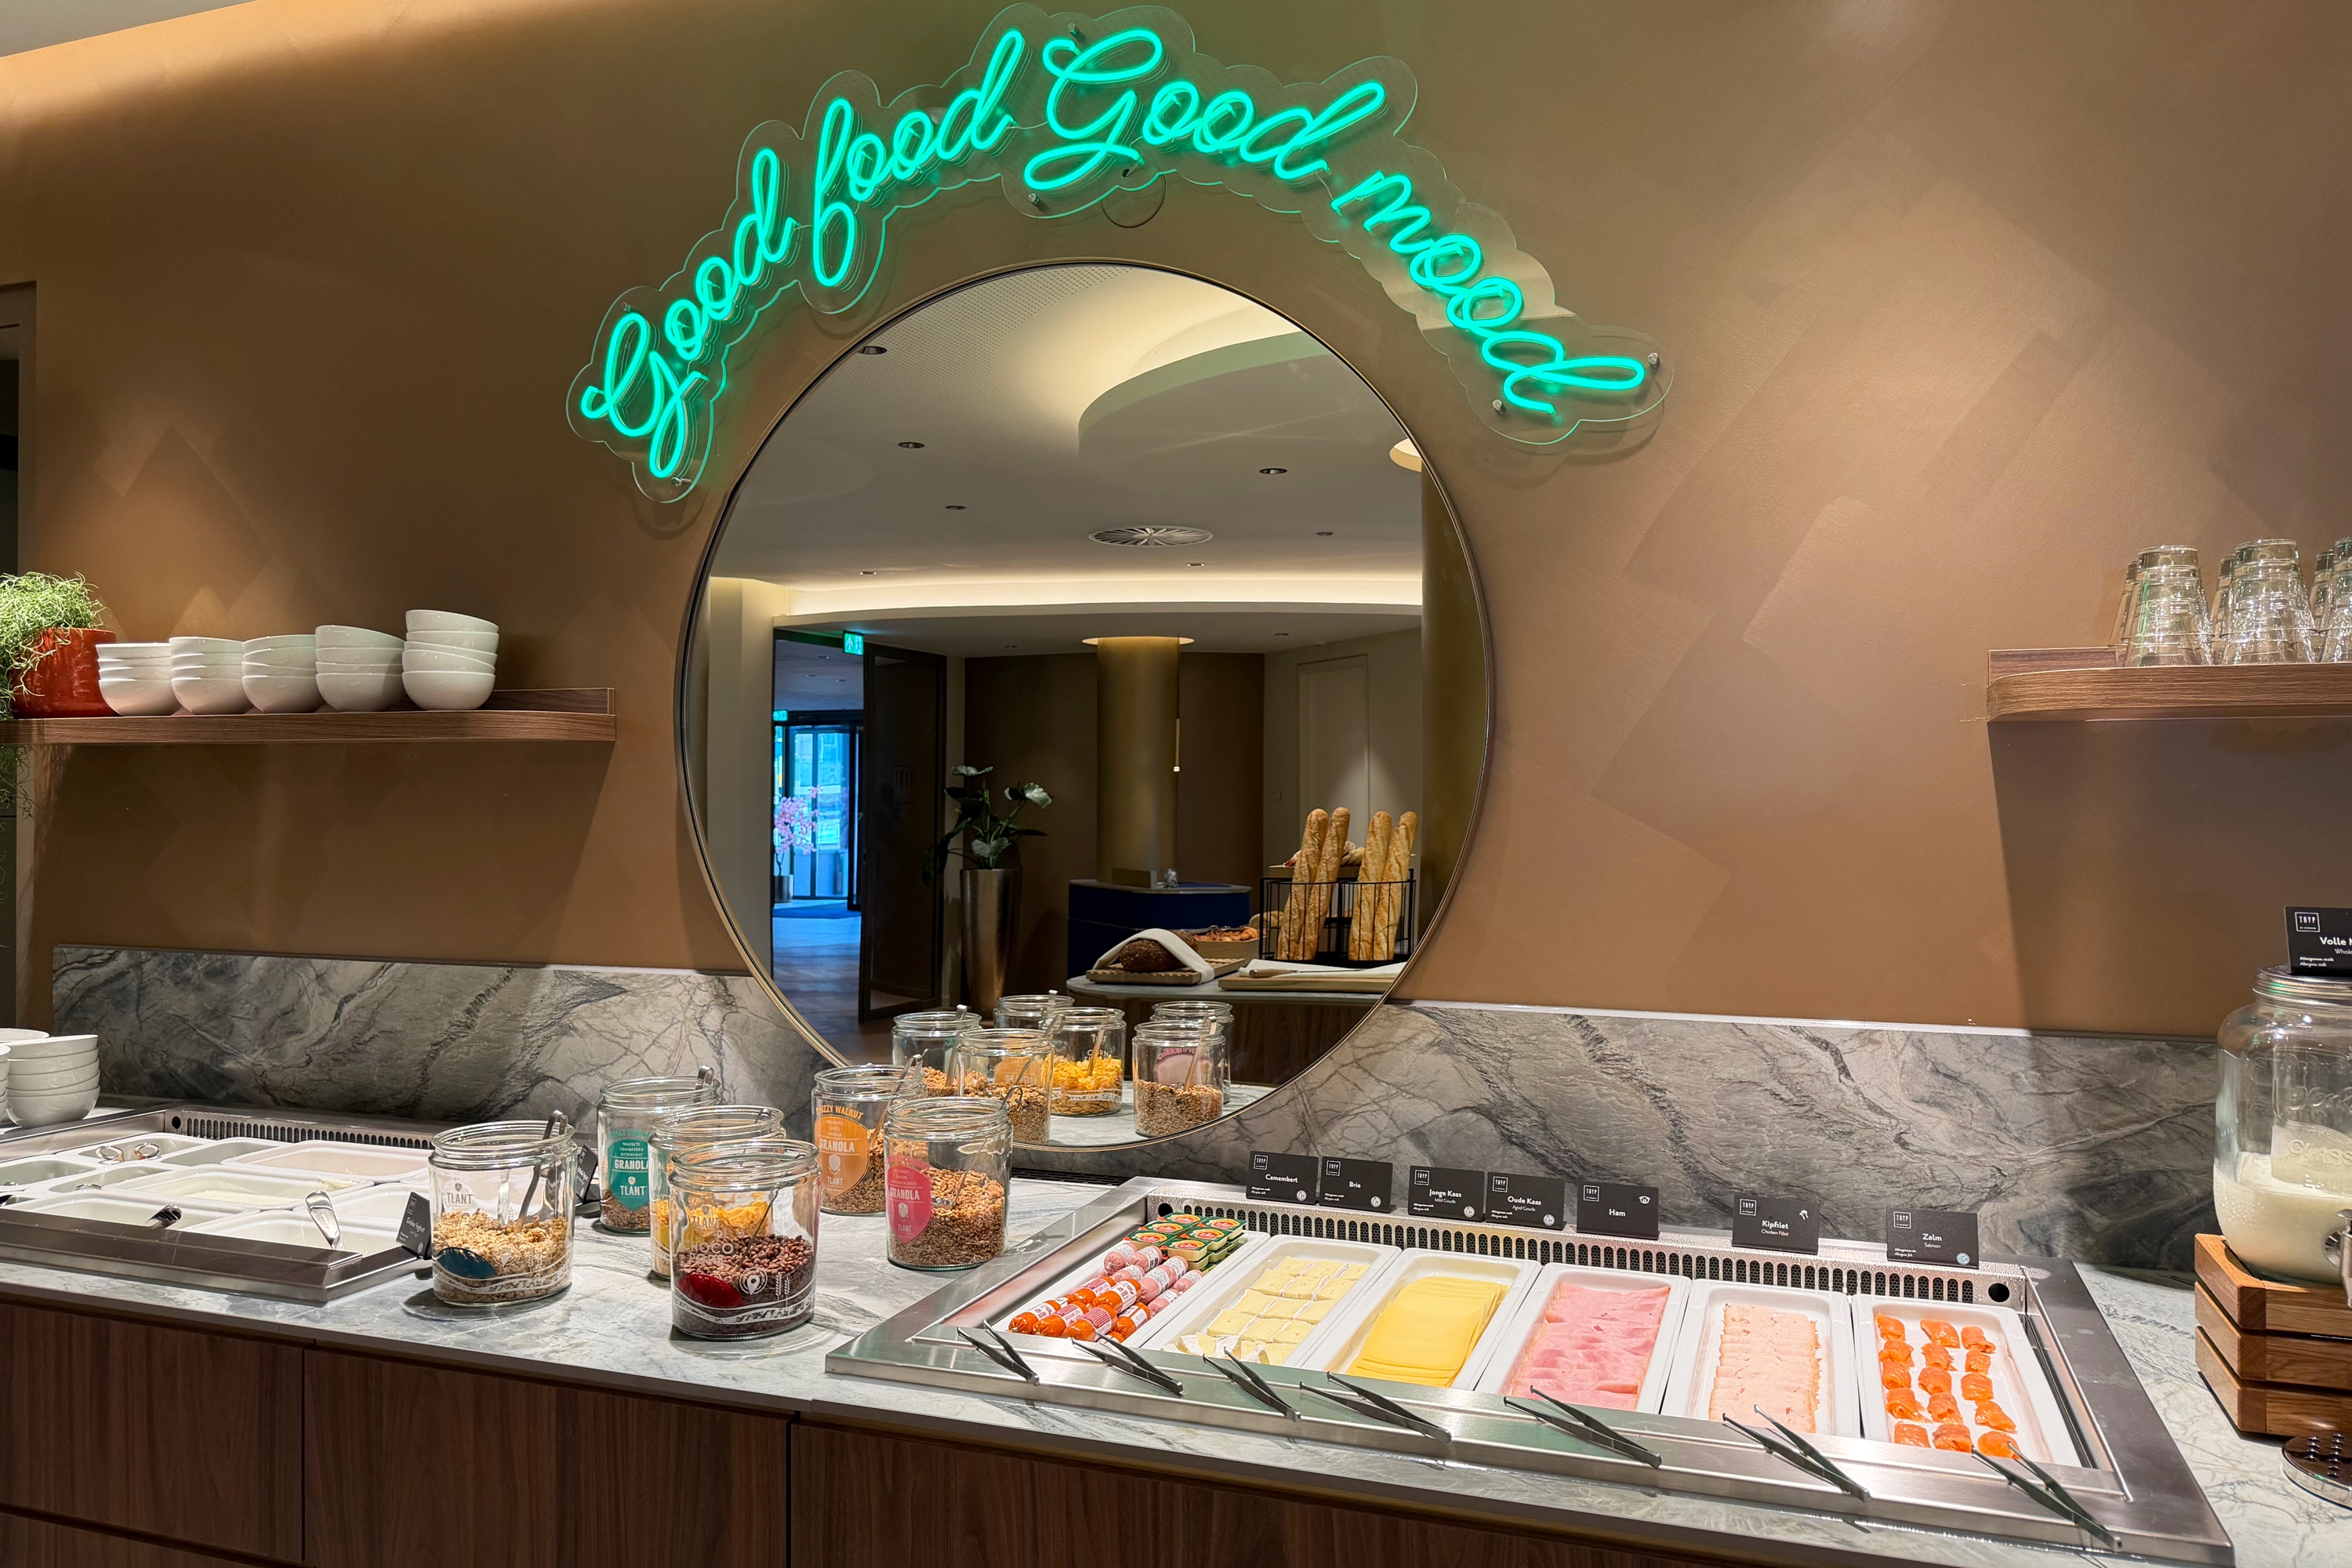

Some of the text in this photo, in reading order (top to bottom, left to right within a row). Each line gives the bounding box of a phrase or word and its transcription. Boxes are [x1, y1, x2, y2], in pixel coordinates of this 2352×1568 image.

[581, 28, 1645, 478] Good food Good mood
[2319, 936, 2347, 946] Volle
[835, 1105, 864, 1120] WALNUT
[819, 1138, 855, 1153] GRANOLA
[827, 1176, 844, 1186] TLANT
[1265, 1174, 1299, 1184] Camembert
[620, 1185, 645, 1196] TLANT
[890, 1186, 920, 1201] GRANOLA
[1429, 1189, 1446, 1198] Jonge
[446, 1192, 473, 1205] TLANT
[1507, 1196, 1526, 1205] Oude
[1609, 1208, 1626, 1217] Ham
[1762, 1220, 1789, 1229] Kipfilet
[1922, 1232, 1942, 1241] Zalm
